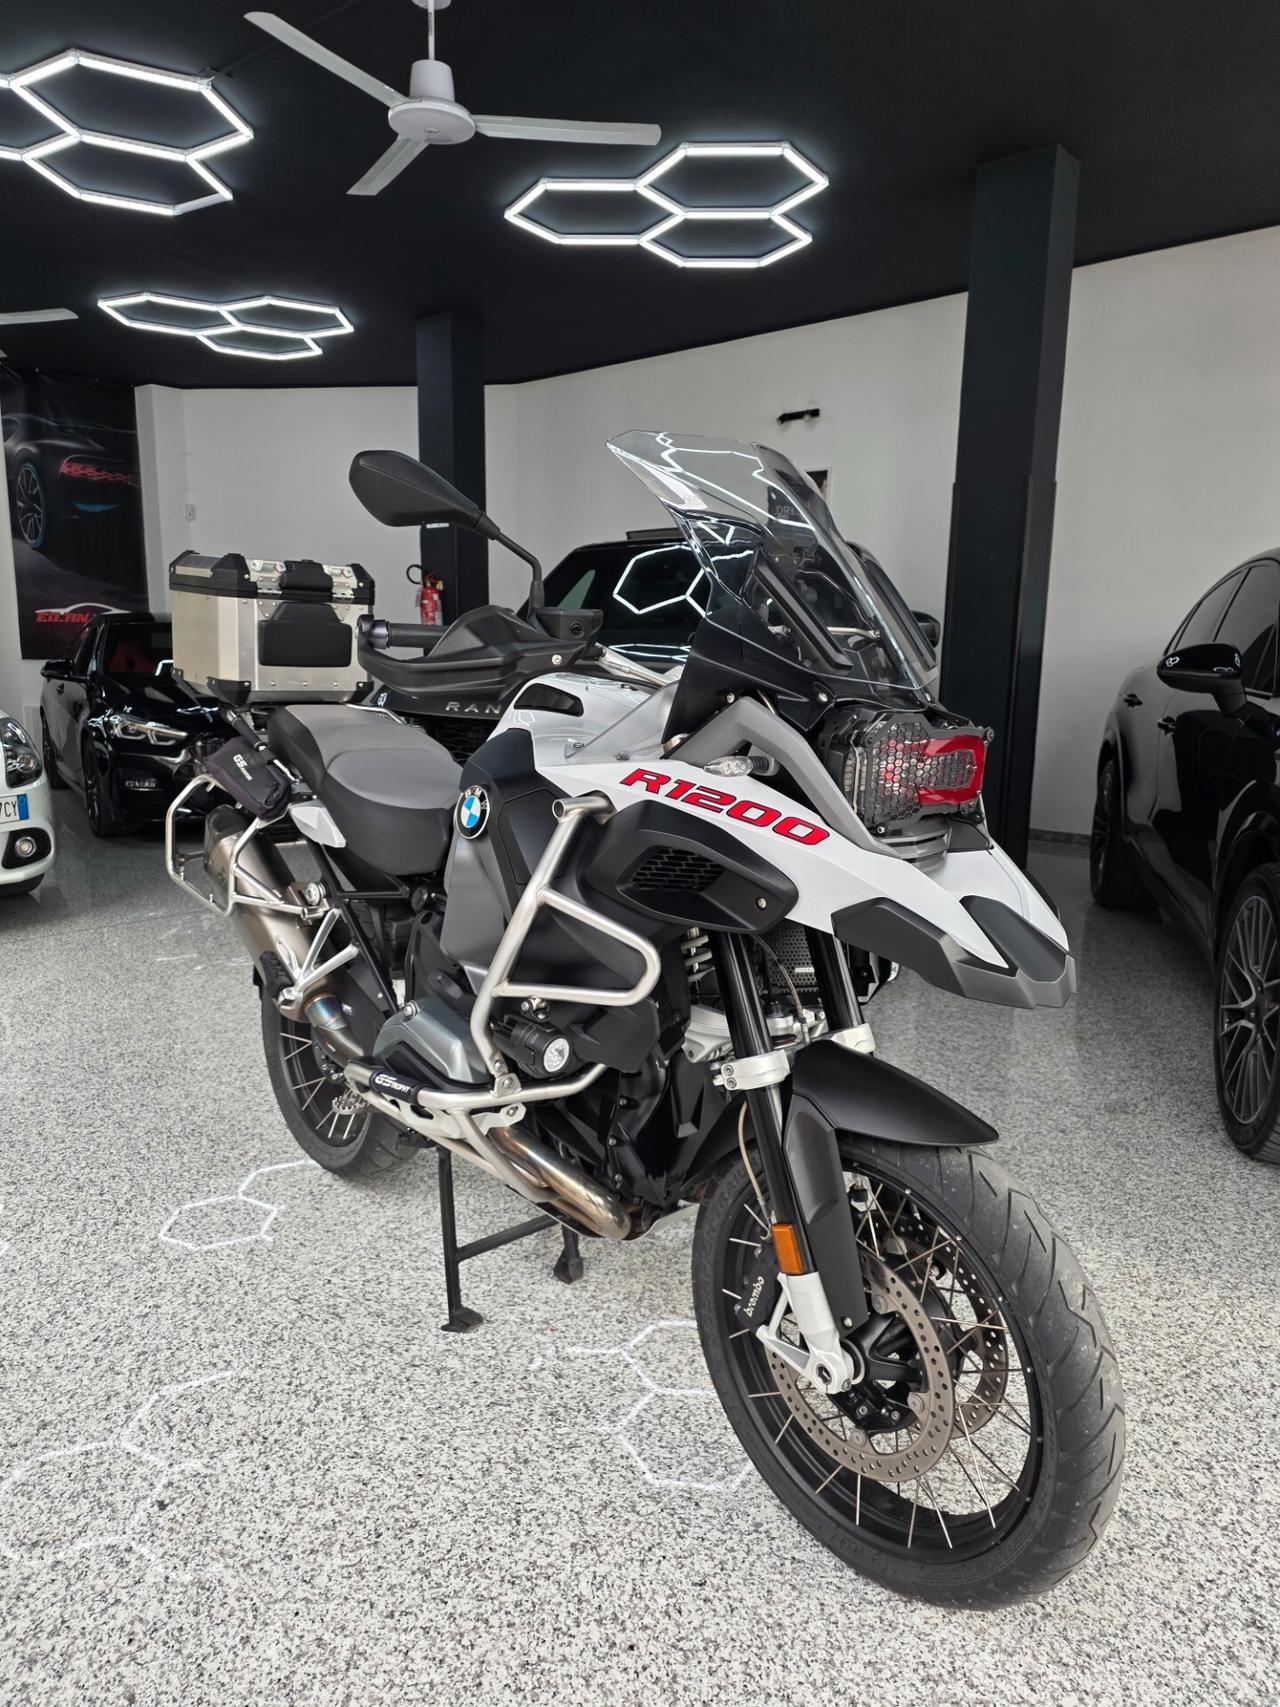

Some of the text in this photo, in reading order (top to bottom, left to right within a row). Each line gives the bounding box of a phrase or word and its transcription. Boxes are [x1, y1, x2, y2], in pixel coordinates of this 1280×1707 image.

[445, 701, 502, 714] RAN
[620, 768, 830, 845] R1200
[743, 1276, 765, 1318] brembo
